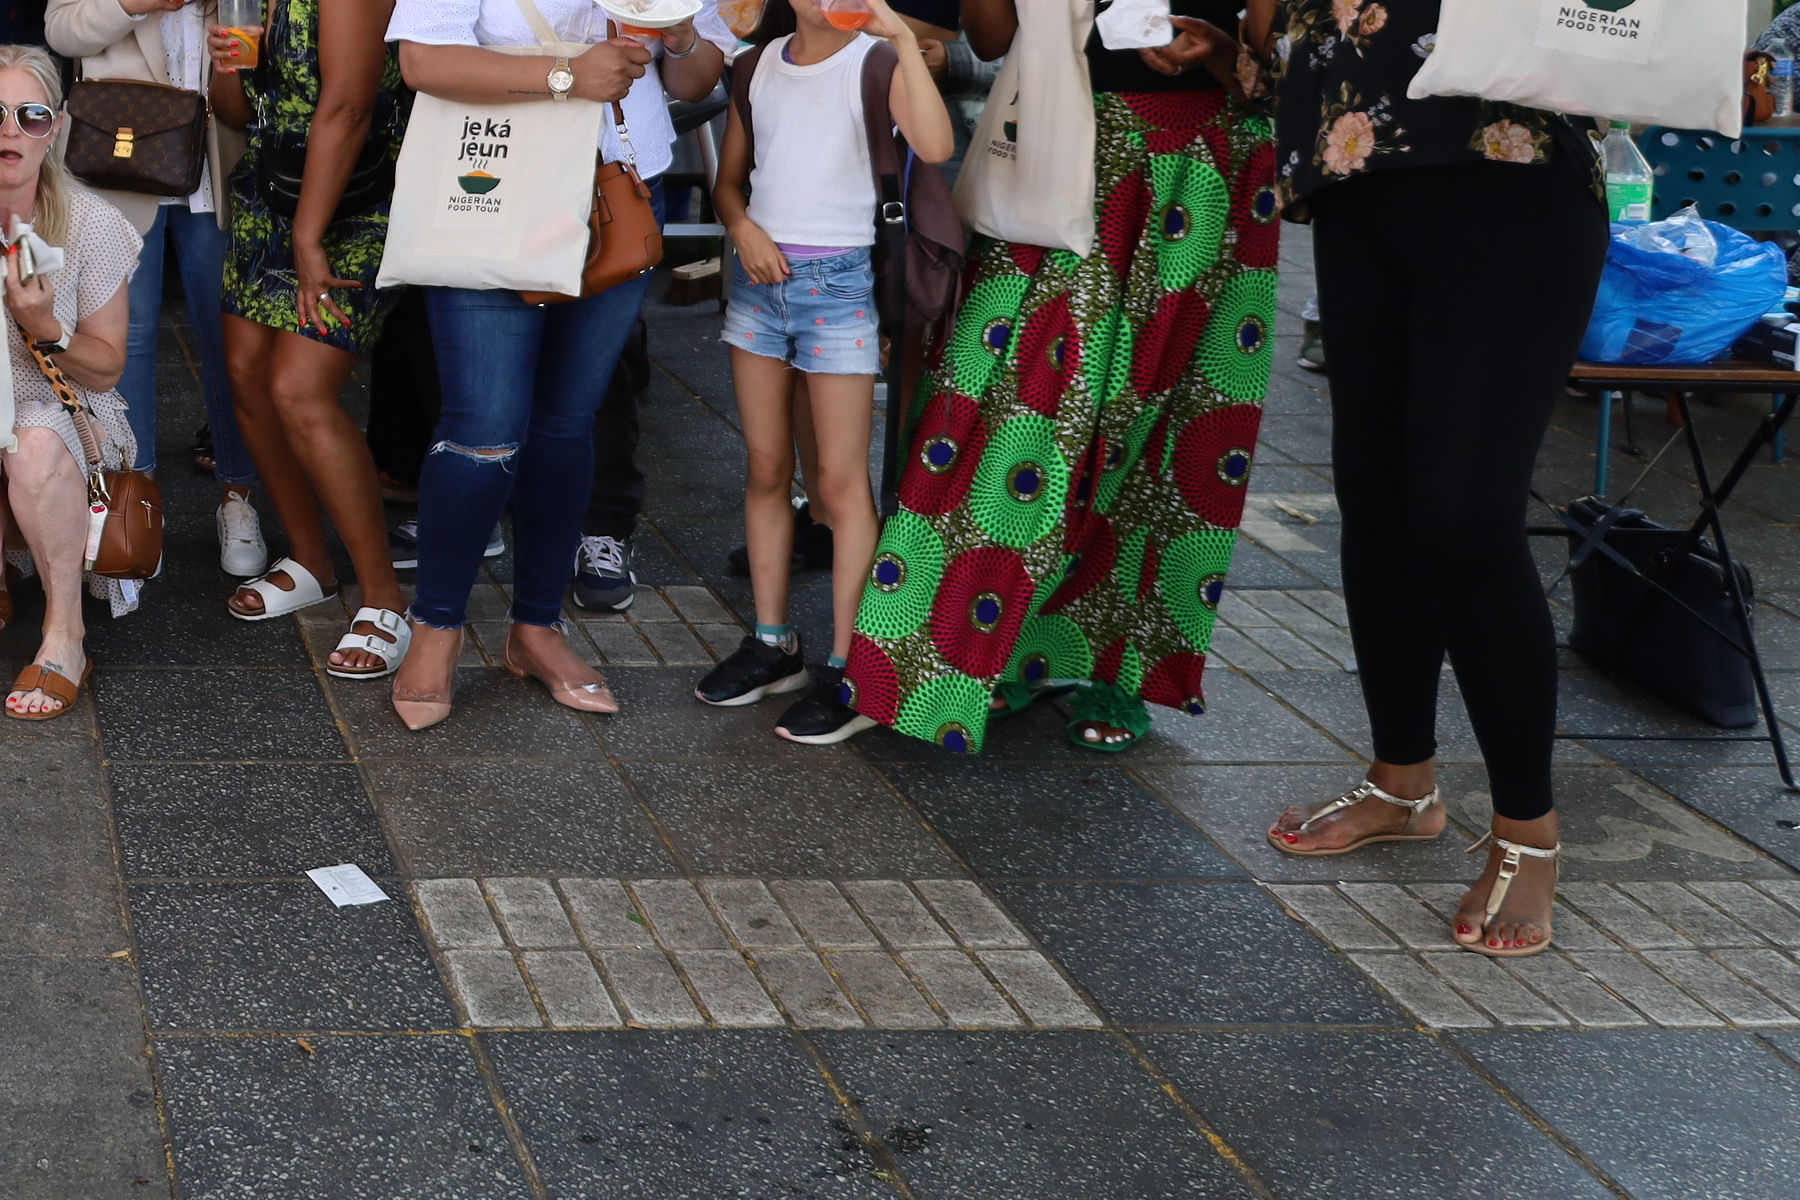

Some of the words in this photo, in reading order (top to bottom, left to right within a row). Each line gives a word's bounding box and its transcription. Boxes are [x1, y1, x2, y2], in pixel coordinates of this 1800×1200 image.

[1560, 6, 1640, 28] NIGERIAN
[1557, 18, 1595, 31] FOOD
[1601, 26, 1638, 39] TOUR
[449, 196, 501, 205] NIGERIAN
[475, 205, 499, 213] TOUR
